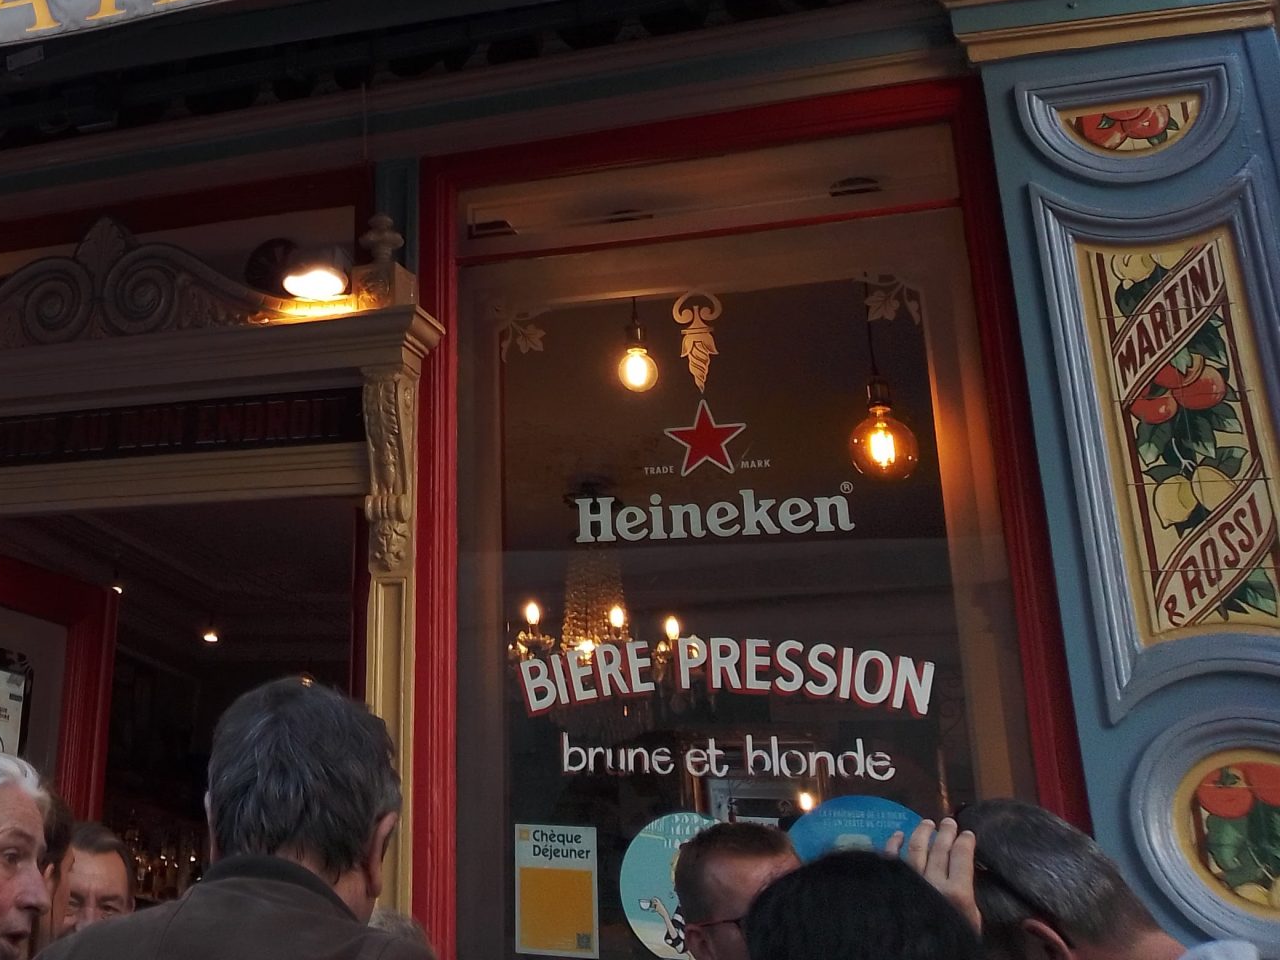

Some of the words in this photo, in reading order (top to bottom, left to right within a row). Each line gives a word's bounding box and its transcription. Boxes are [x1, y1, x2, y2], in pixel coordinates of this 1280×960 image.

[1117, 246, 1221, 383] MARTINI
[643, 465, 675, 476] TRADE
[740, 459, 771, 469] MARK
[574, 488, 856, 543] Heineken
[1179, 493, 1263, 613] ROSSI
[676, 636, 936, 716] PRESSION
[561, 732, 675, 776] brune
[684, 738, 730, 776] et
[745, 735, 897, 781] blonde
[532, 829, 582, 845] Chèque
[532, 843, 591, 861] Déjeuner
